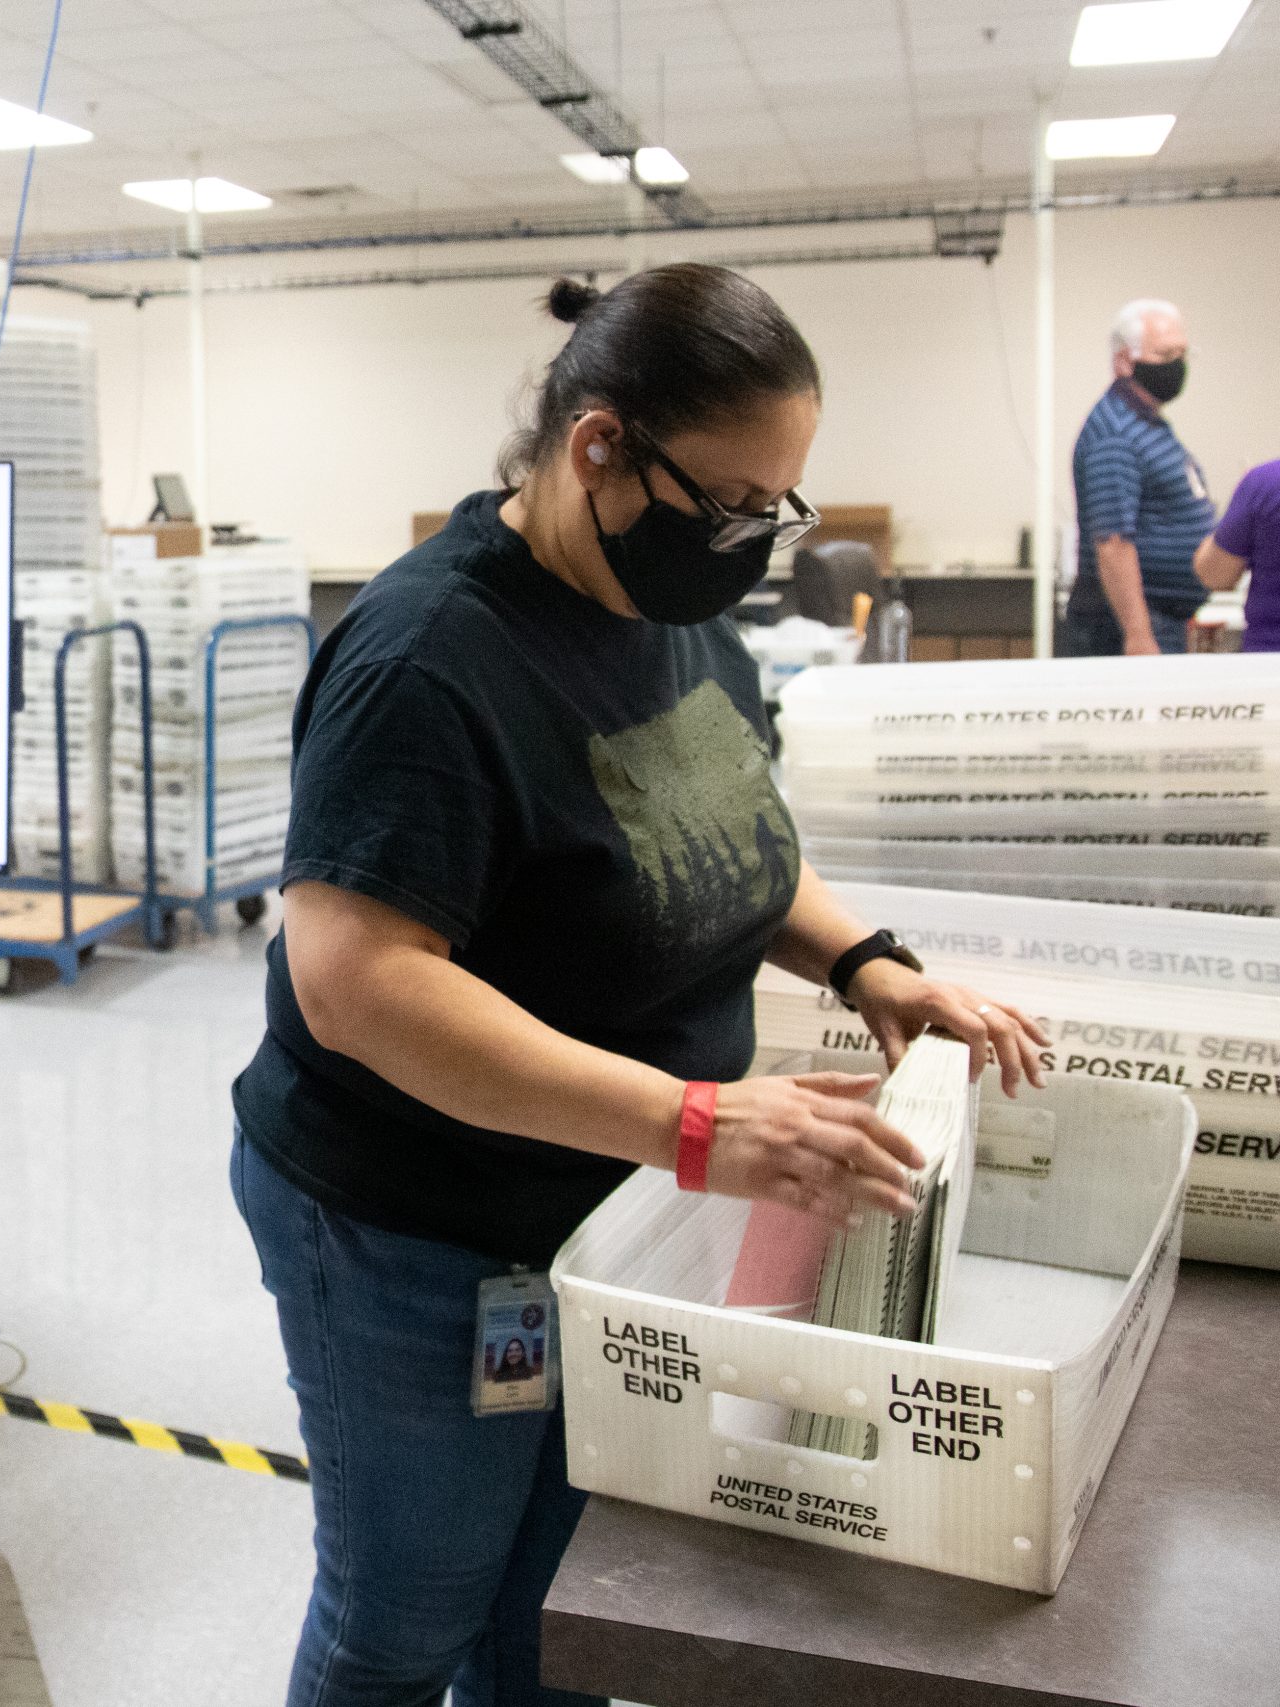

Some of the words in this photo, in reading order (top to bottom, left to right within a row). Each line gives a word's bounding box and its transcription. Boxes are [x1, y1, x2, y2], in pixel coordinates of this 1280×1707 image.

[1160, 703, 1265, 720] SERVICE
[1060, 1020, 1186, 1056] POSTAL
[1066, 1054, 1193, 1089] POSTAL
[604, 1316, 699, 1358] LABEL
[603, 1342, 701, 1384] OTHER
[623, 1371, 683, 1404] END
[891, 1374, 1002, 1411] LABEL
[888, 1401, 1004, 1438] OTHER
[912, 1432, 980, 1461] END
[710, 1490, 790, 1521] POSTAL
[794, 1509, 888, 1542] SERVICE
[717, 1474, 793, 1502] UNITED
[797, 1492, 878, 1521] STATES
